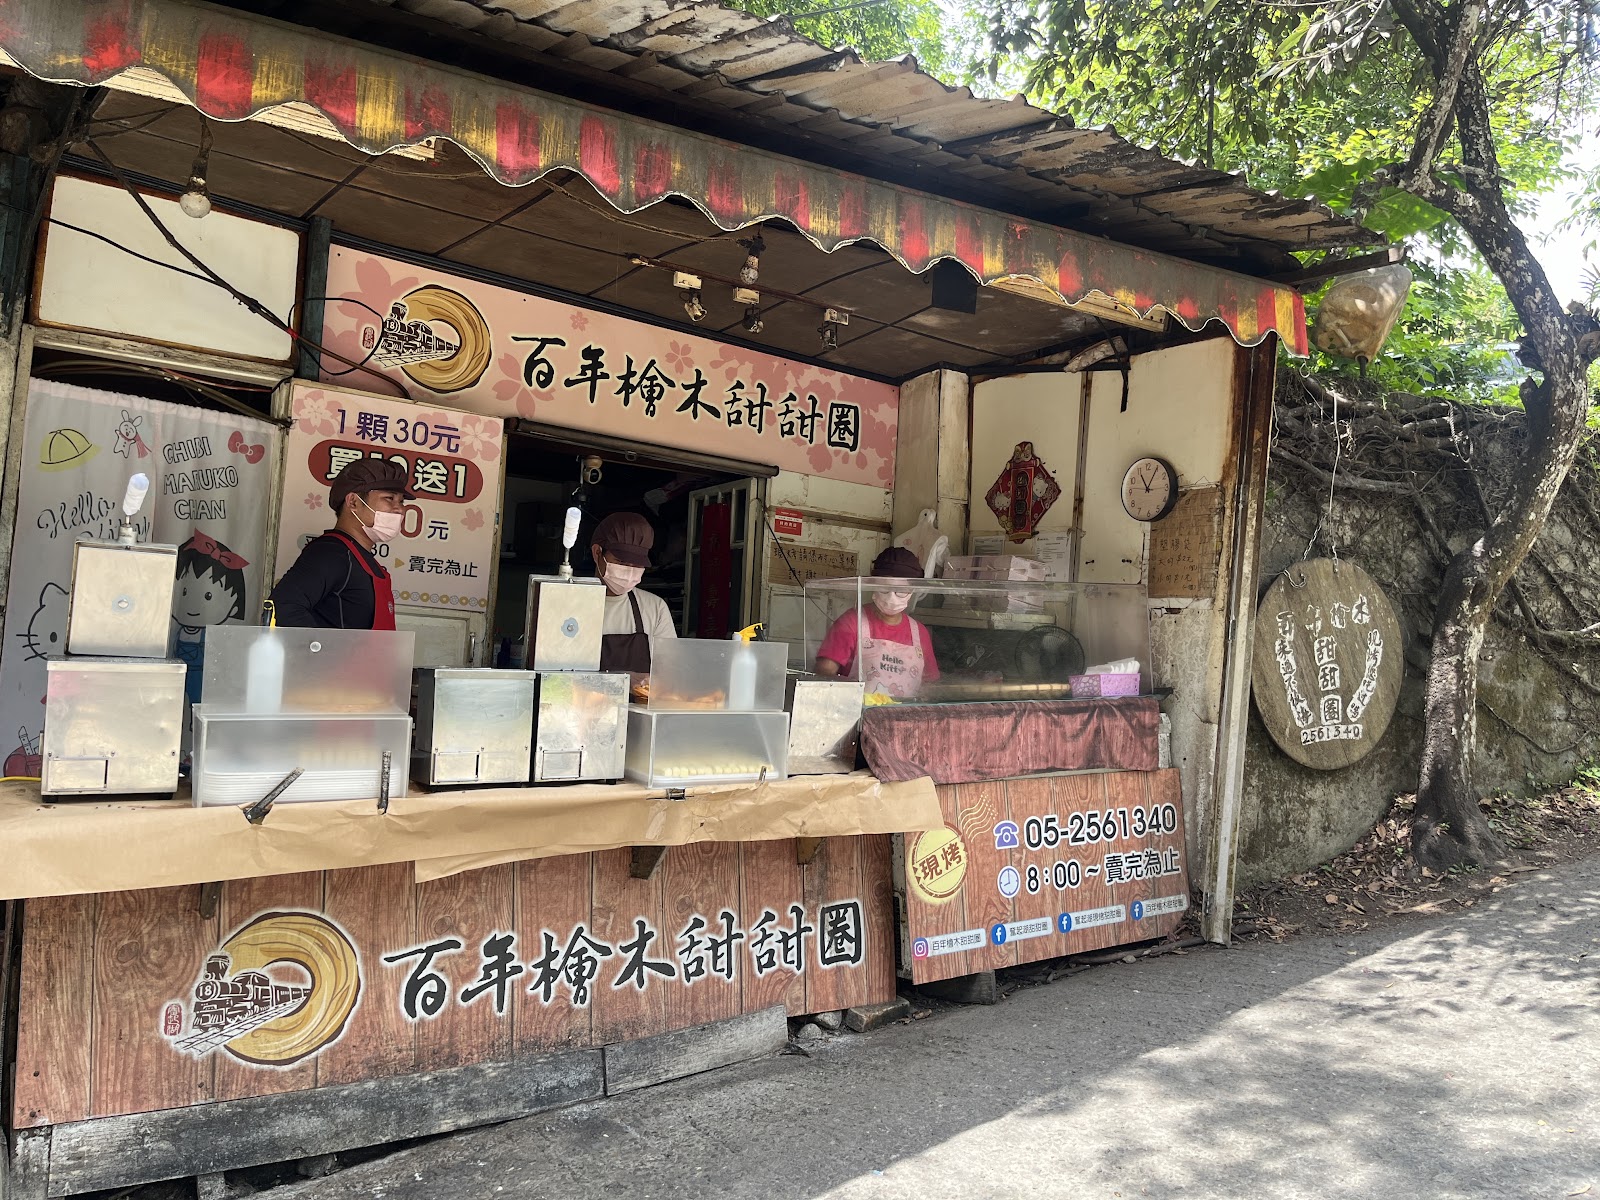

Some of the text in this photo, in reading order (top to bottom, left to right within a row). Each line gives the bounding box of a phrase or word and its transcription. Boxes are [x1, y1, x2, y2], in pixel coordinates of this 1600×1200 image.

[387, 321, 396, 330] 18
[510, 335, 860, 452] 百年檜木甜甜圈
[337, 408, 461, 453] 1顆30元
[163, 436, 212, 465] CHIBI
[164, 465, 239, 495] MARUKO
[37, 491, 116, 539] Hello
[174, 499, 226, 520] CHAN
[409, 555, 478, 578] 賣完為止
[882, 654, 904, 665] Hello
[1302, 726, 1362, 745] 2561340
[1025, 805, 1176, 849] 05-2561340
[919, 842, 963, 881] 現烤
[383, 902, 863, 1022] 百年檜木甜甜圈
[199, 984, 213, 998] 18
